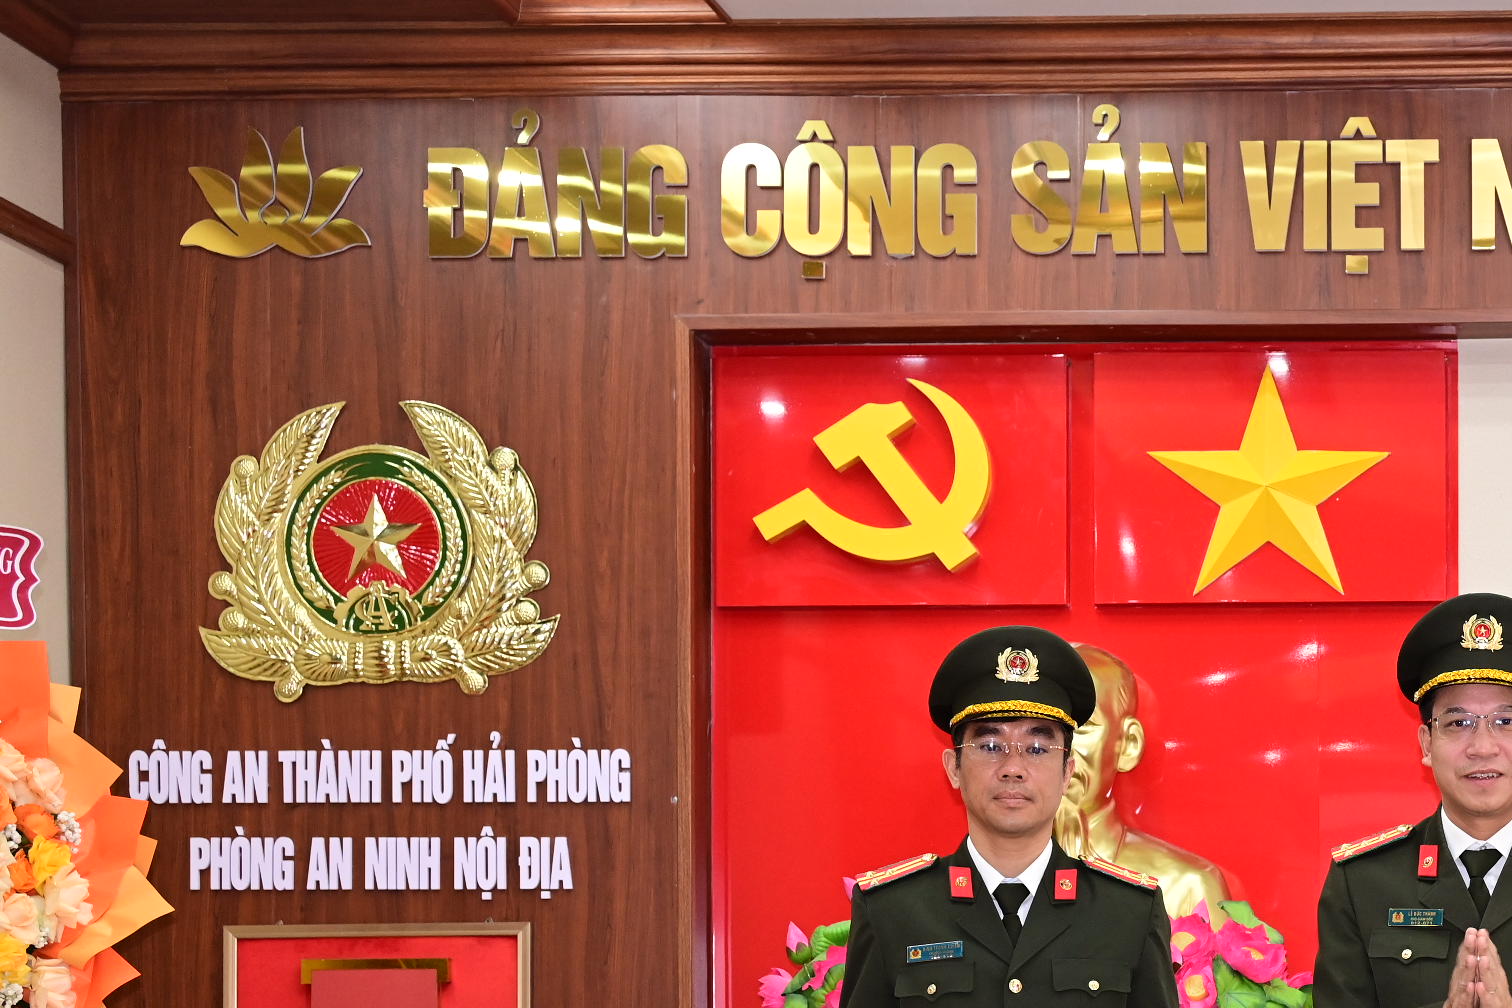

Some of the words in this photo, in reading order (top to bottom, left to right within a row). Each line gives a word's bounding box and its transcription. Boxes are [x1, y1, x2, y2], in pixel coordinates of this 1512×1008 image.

[423, 108, 688, 258] ĐẢNG
[720, 120, 978, 279] CỘNG
[1011, 104, 1207, 255] SẢN
[1240, 116, 1440, 274] VIỆT
[128, 739, 213, 804] CÔNG
[223, 750, 269, 804] AN
[278, 739, 382, 804] THÀNH
[392, 733, 457, 804] PHỐ
[462, 731, 516, 804] HẢI
[527, 737, 632, 804] PHÒNG
[189, 826, 295, 891] PHÒNG
[307, 837, 354, 891] AN
[364, 837, 441, 891] NINH
[453, 826, 507, 900] NỘI
[518, 837, 574, 900] ĐỊA
